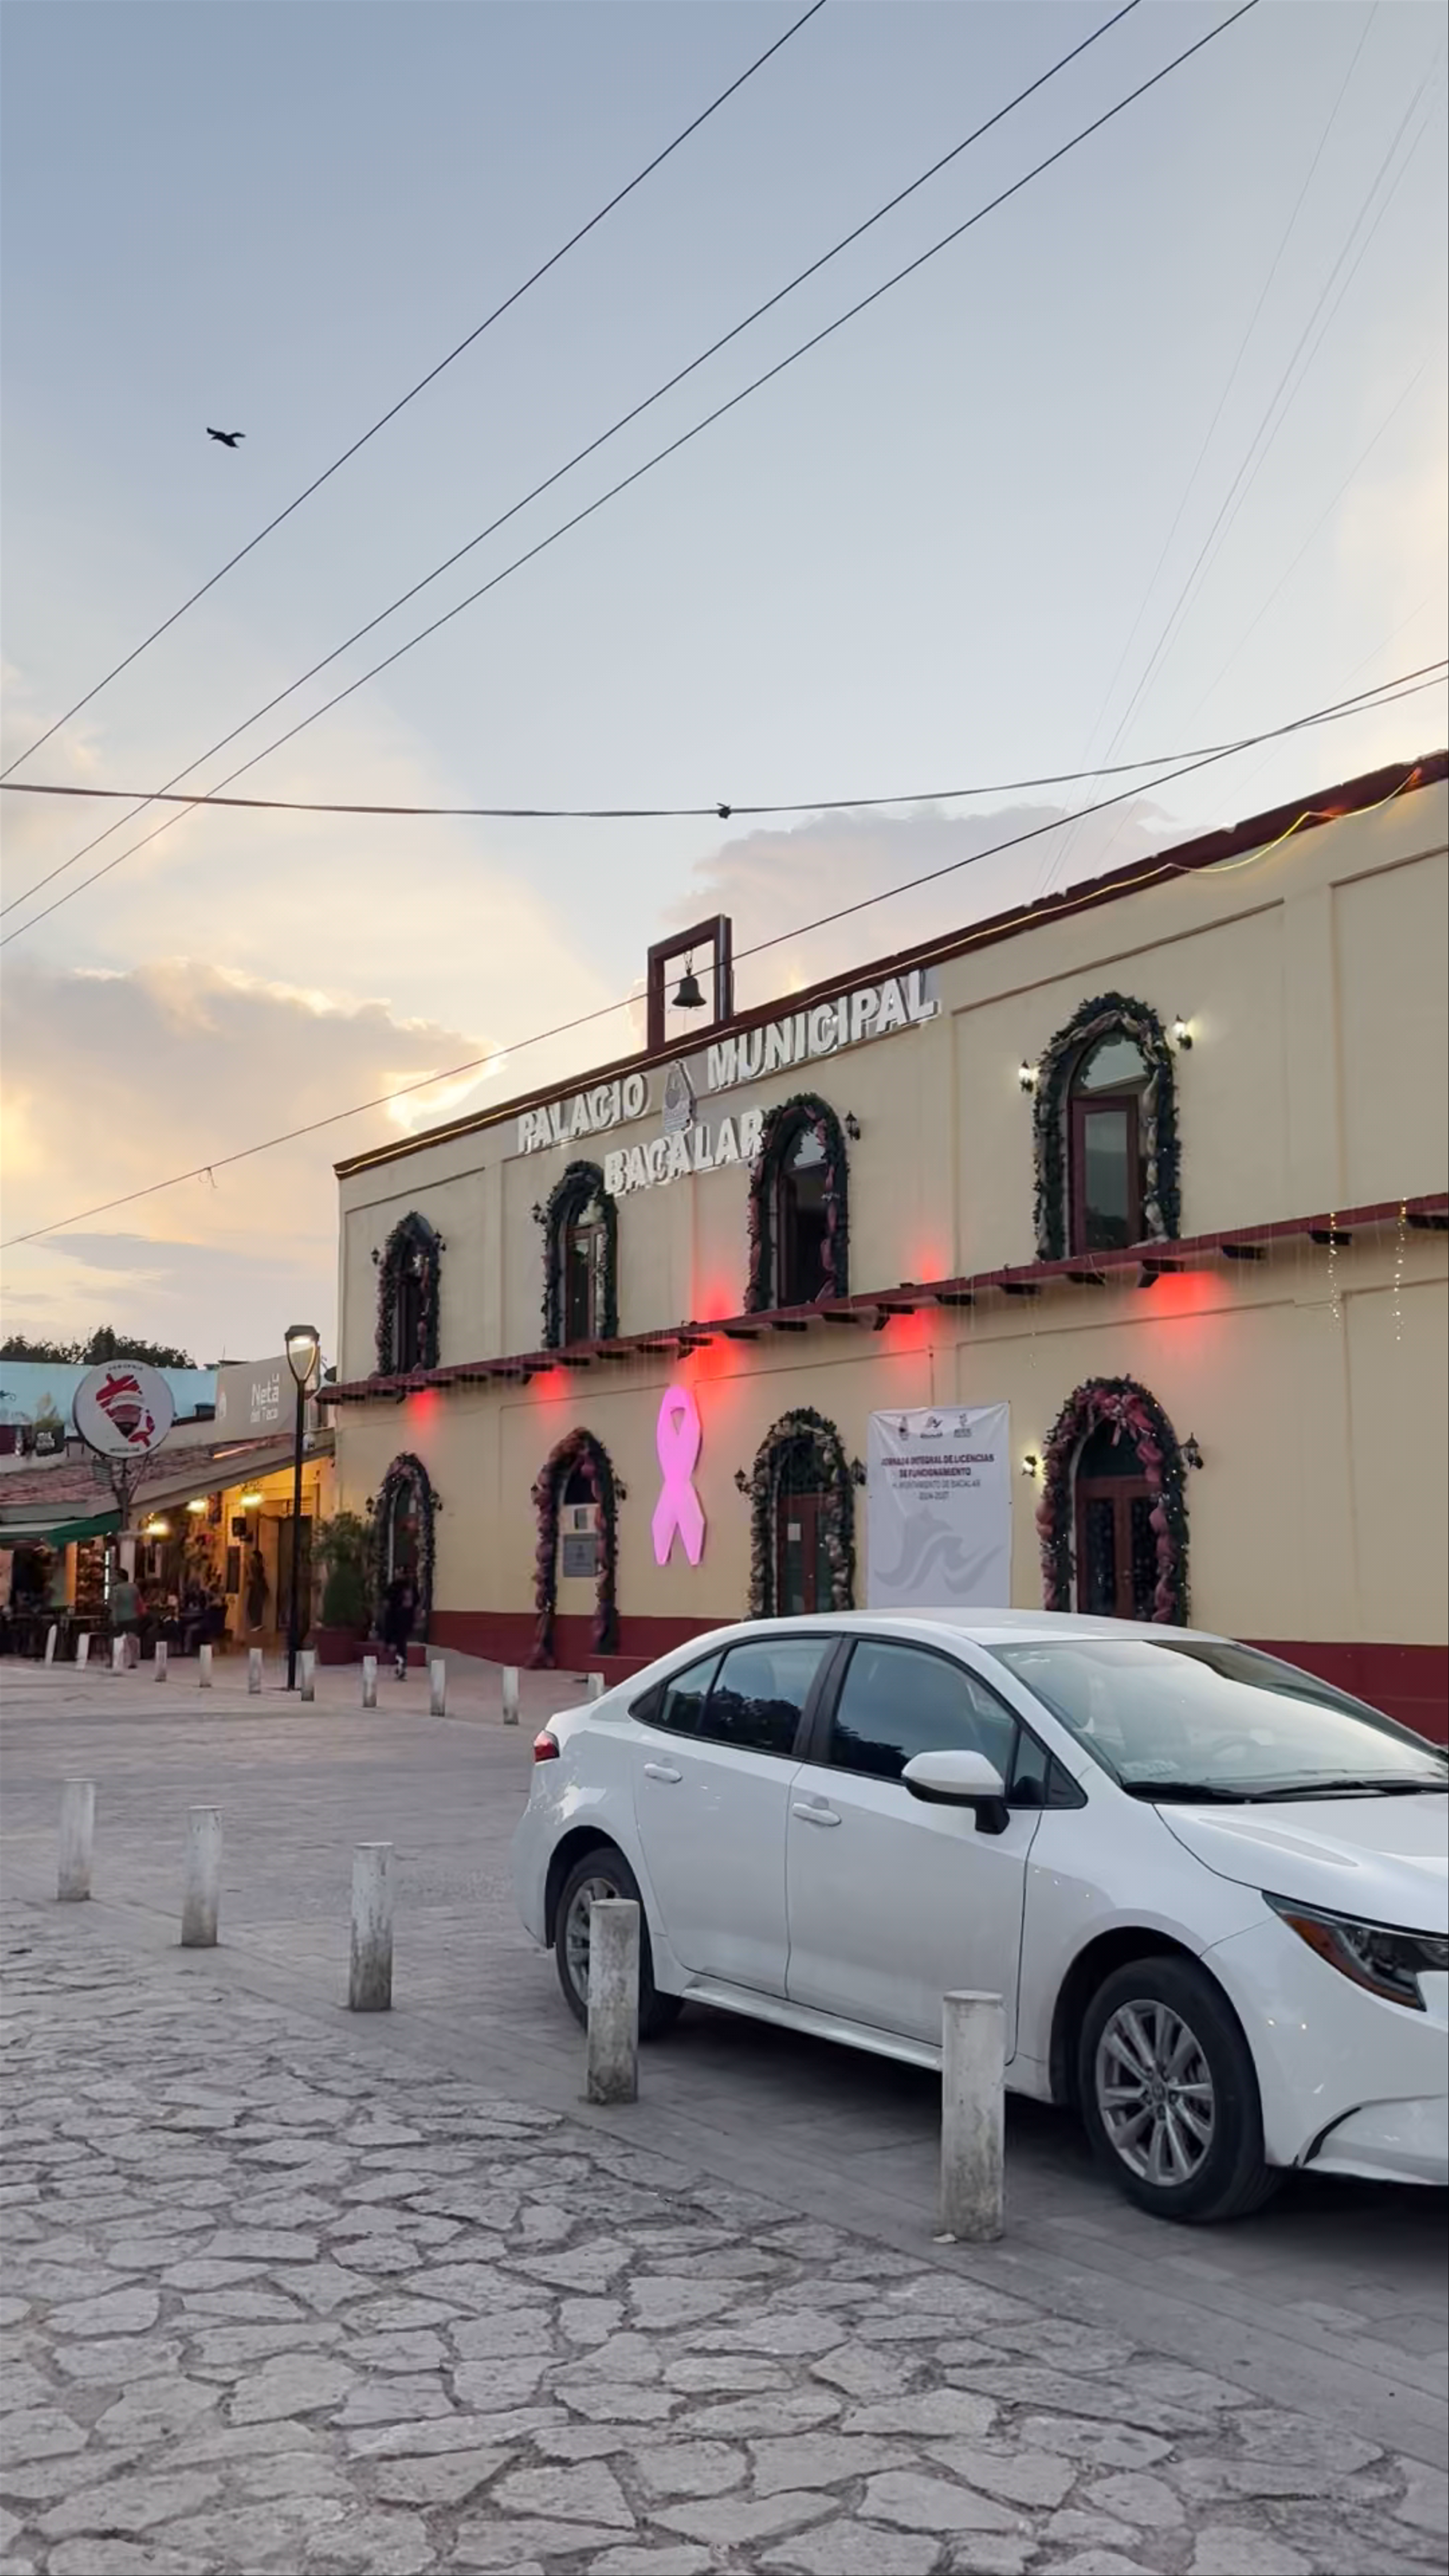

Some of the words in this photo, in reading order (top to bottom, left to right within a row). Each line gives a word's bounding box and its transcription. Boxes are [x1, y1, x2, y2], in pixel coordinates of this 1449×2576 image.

[518, 1074, 648, 1154] PALACIO
[708, 969, 938, 1091] MUNICIPAL
[605, 1109, 764, 1196] BACALAR
[251, 1380, 279, 1406] Neta
[911, 1455, 942, 1465] INTEGRAL
[943, 1455, 953, 1464] DE
[954, 1453, 994, 1463] LICENCIAS
[909, 1467, 971, 1477] FUNCIONAMIENTO
[951, 1479, 981, 1487] BACALAR
